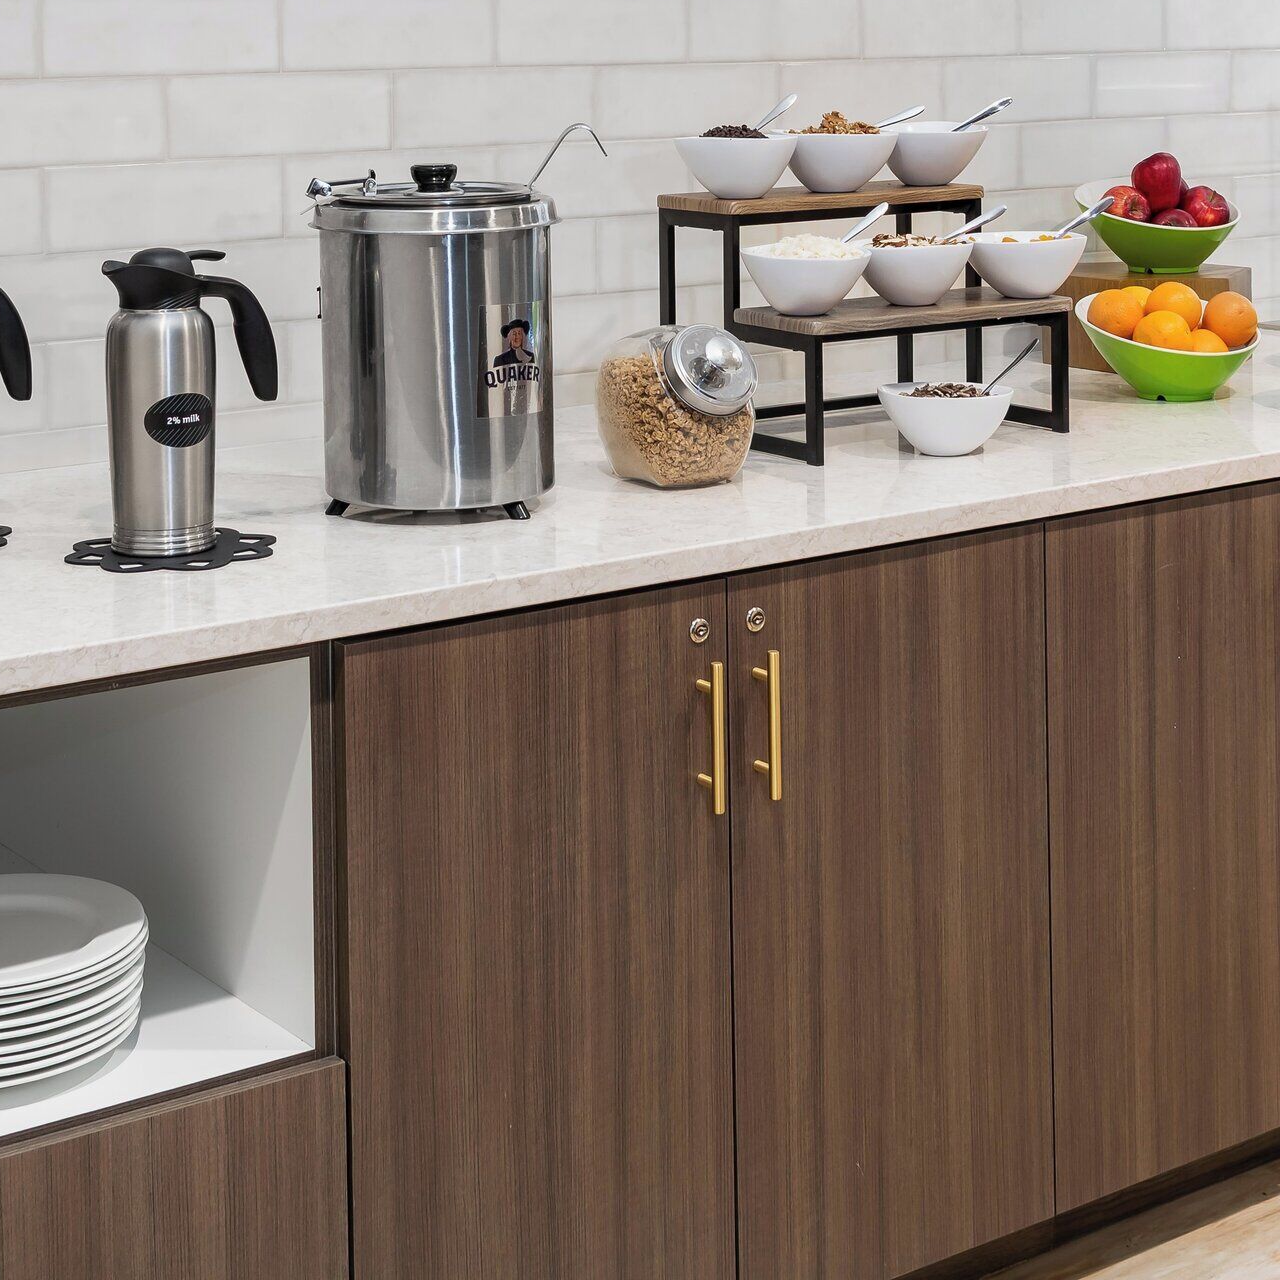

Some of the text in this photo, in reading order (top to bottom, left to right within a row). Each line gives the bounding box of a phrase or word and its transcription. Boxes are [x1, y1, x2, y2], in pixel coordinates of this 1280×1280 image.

[484, 365, 540, 389] QUAKER
[166, 413, 201, 426] 2% milk
